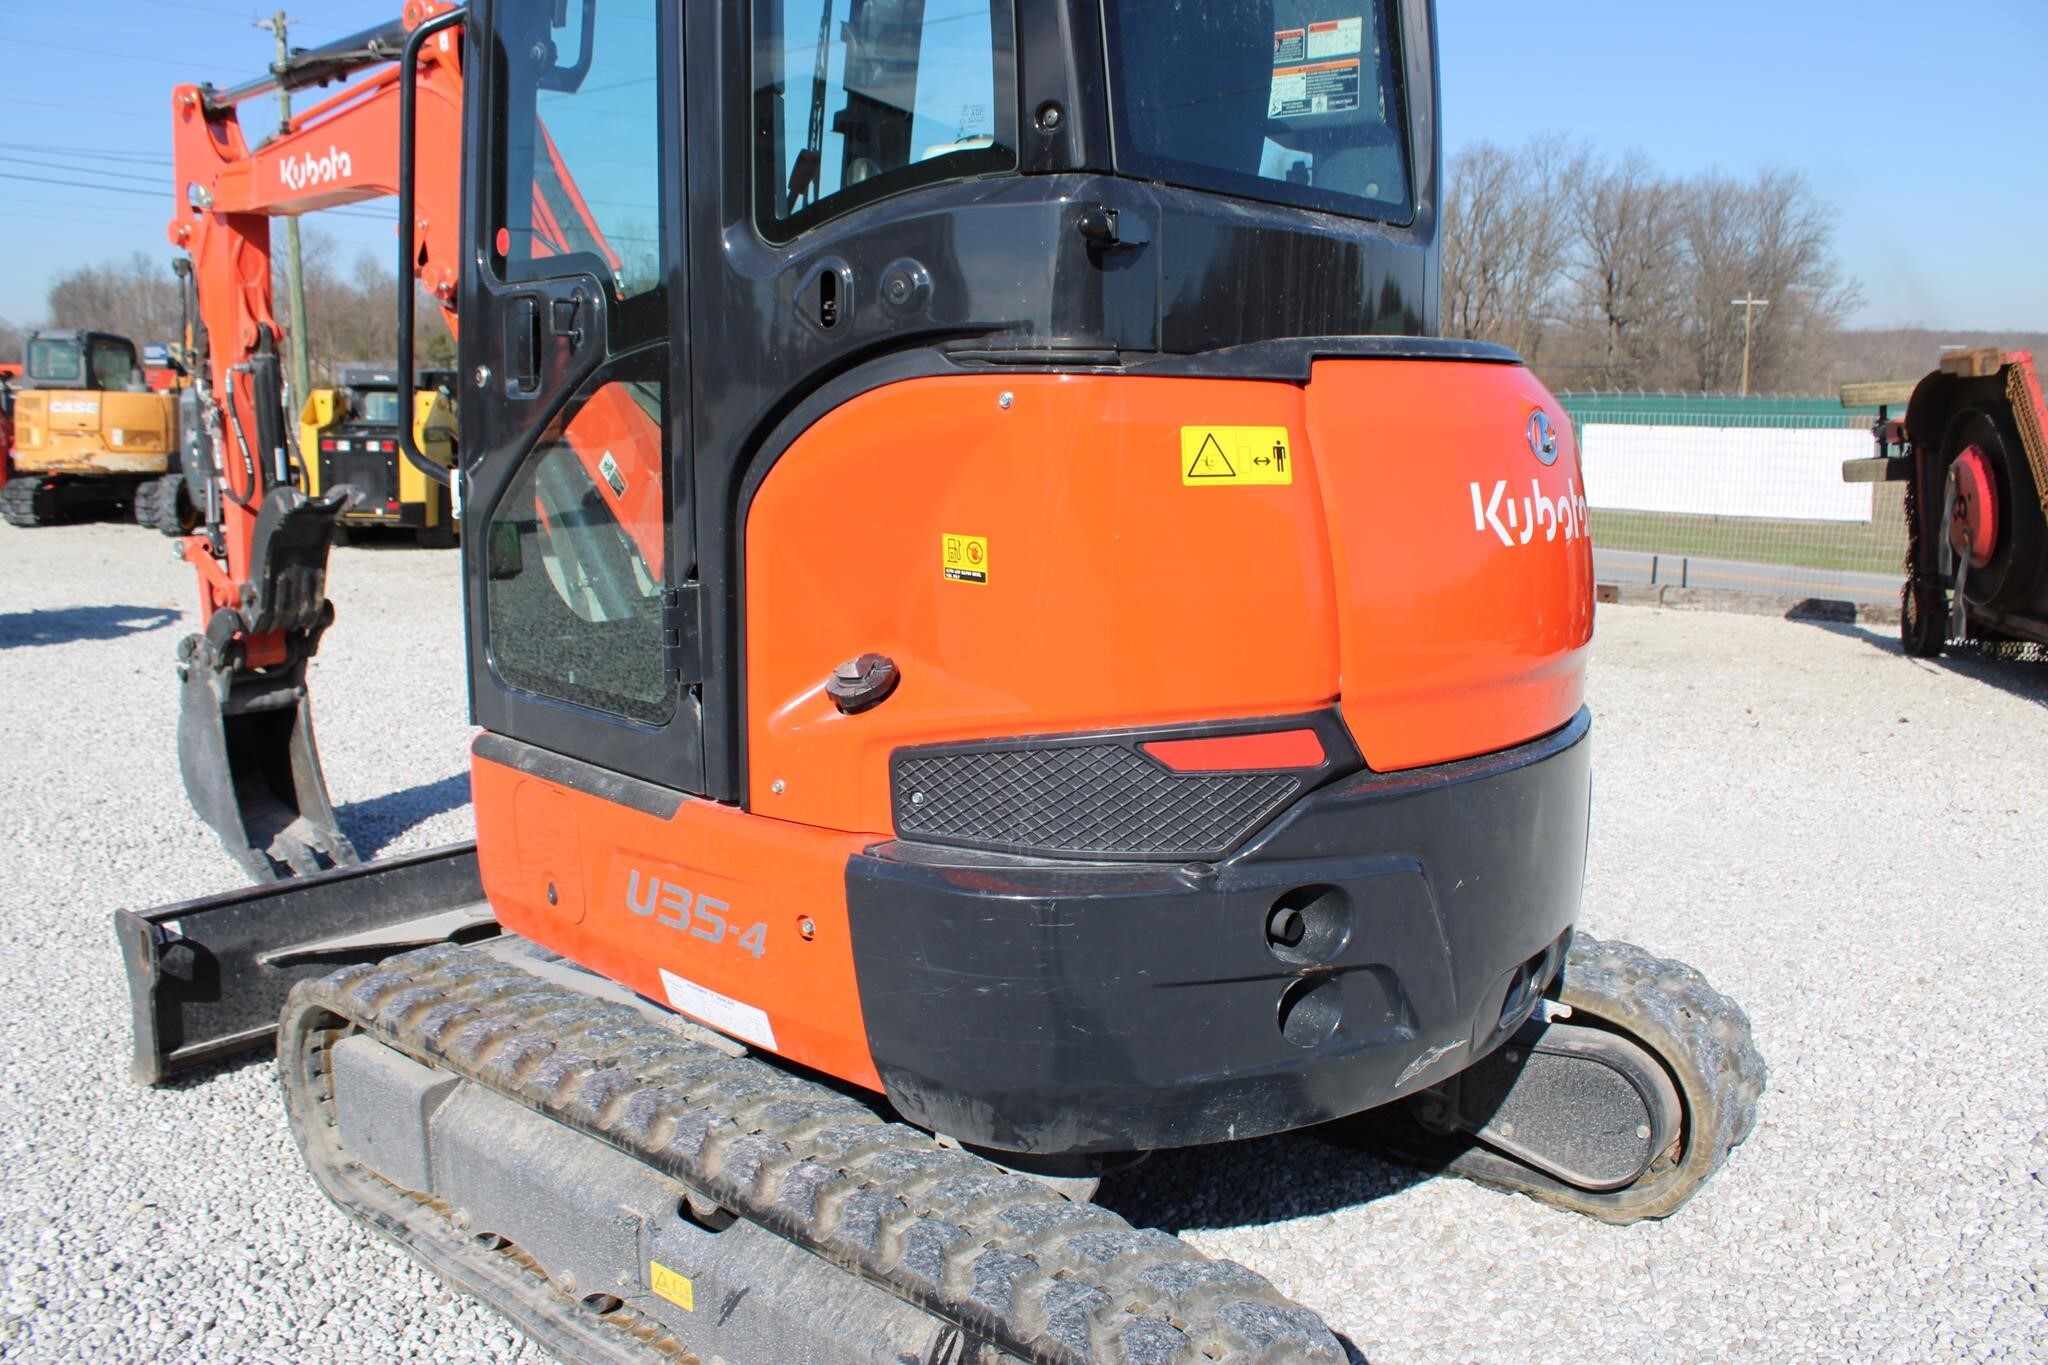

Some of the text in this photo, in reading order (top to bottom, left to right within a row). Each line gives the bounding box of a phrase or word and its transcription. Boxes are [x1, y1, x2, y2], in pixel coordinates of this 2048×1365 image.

[280, 144, 352, 191] Kubota
[49, 401, 98, 414] CASE
[1470, 478, 1591, 547] Kubota
[626, 869, 768, 959] U35-4
